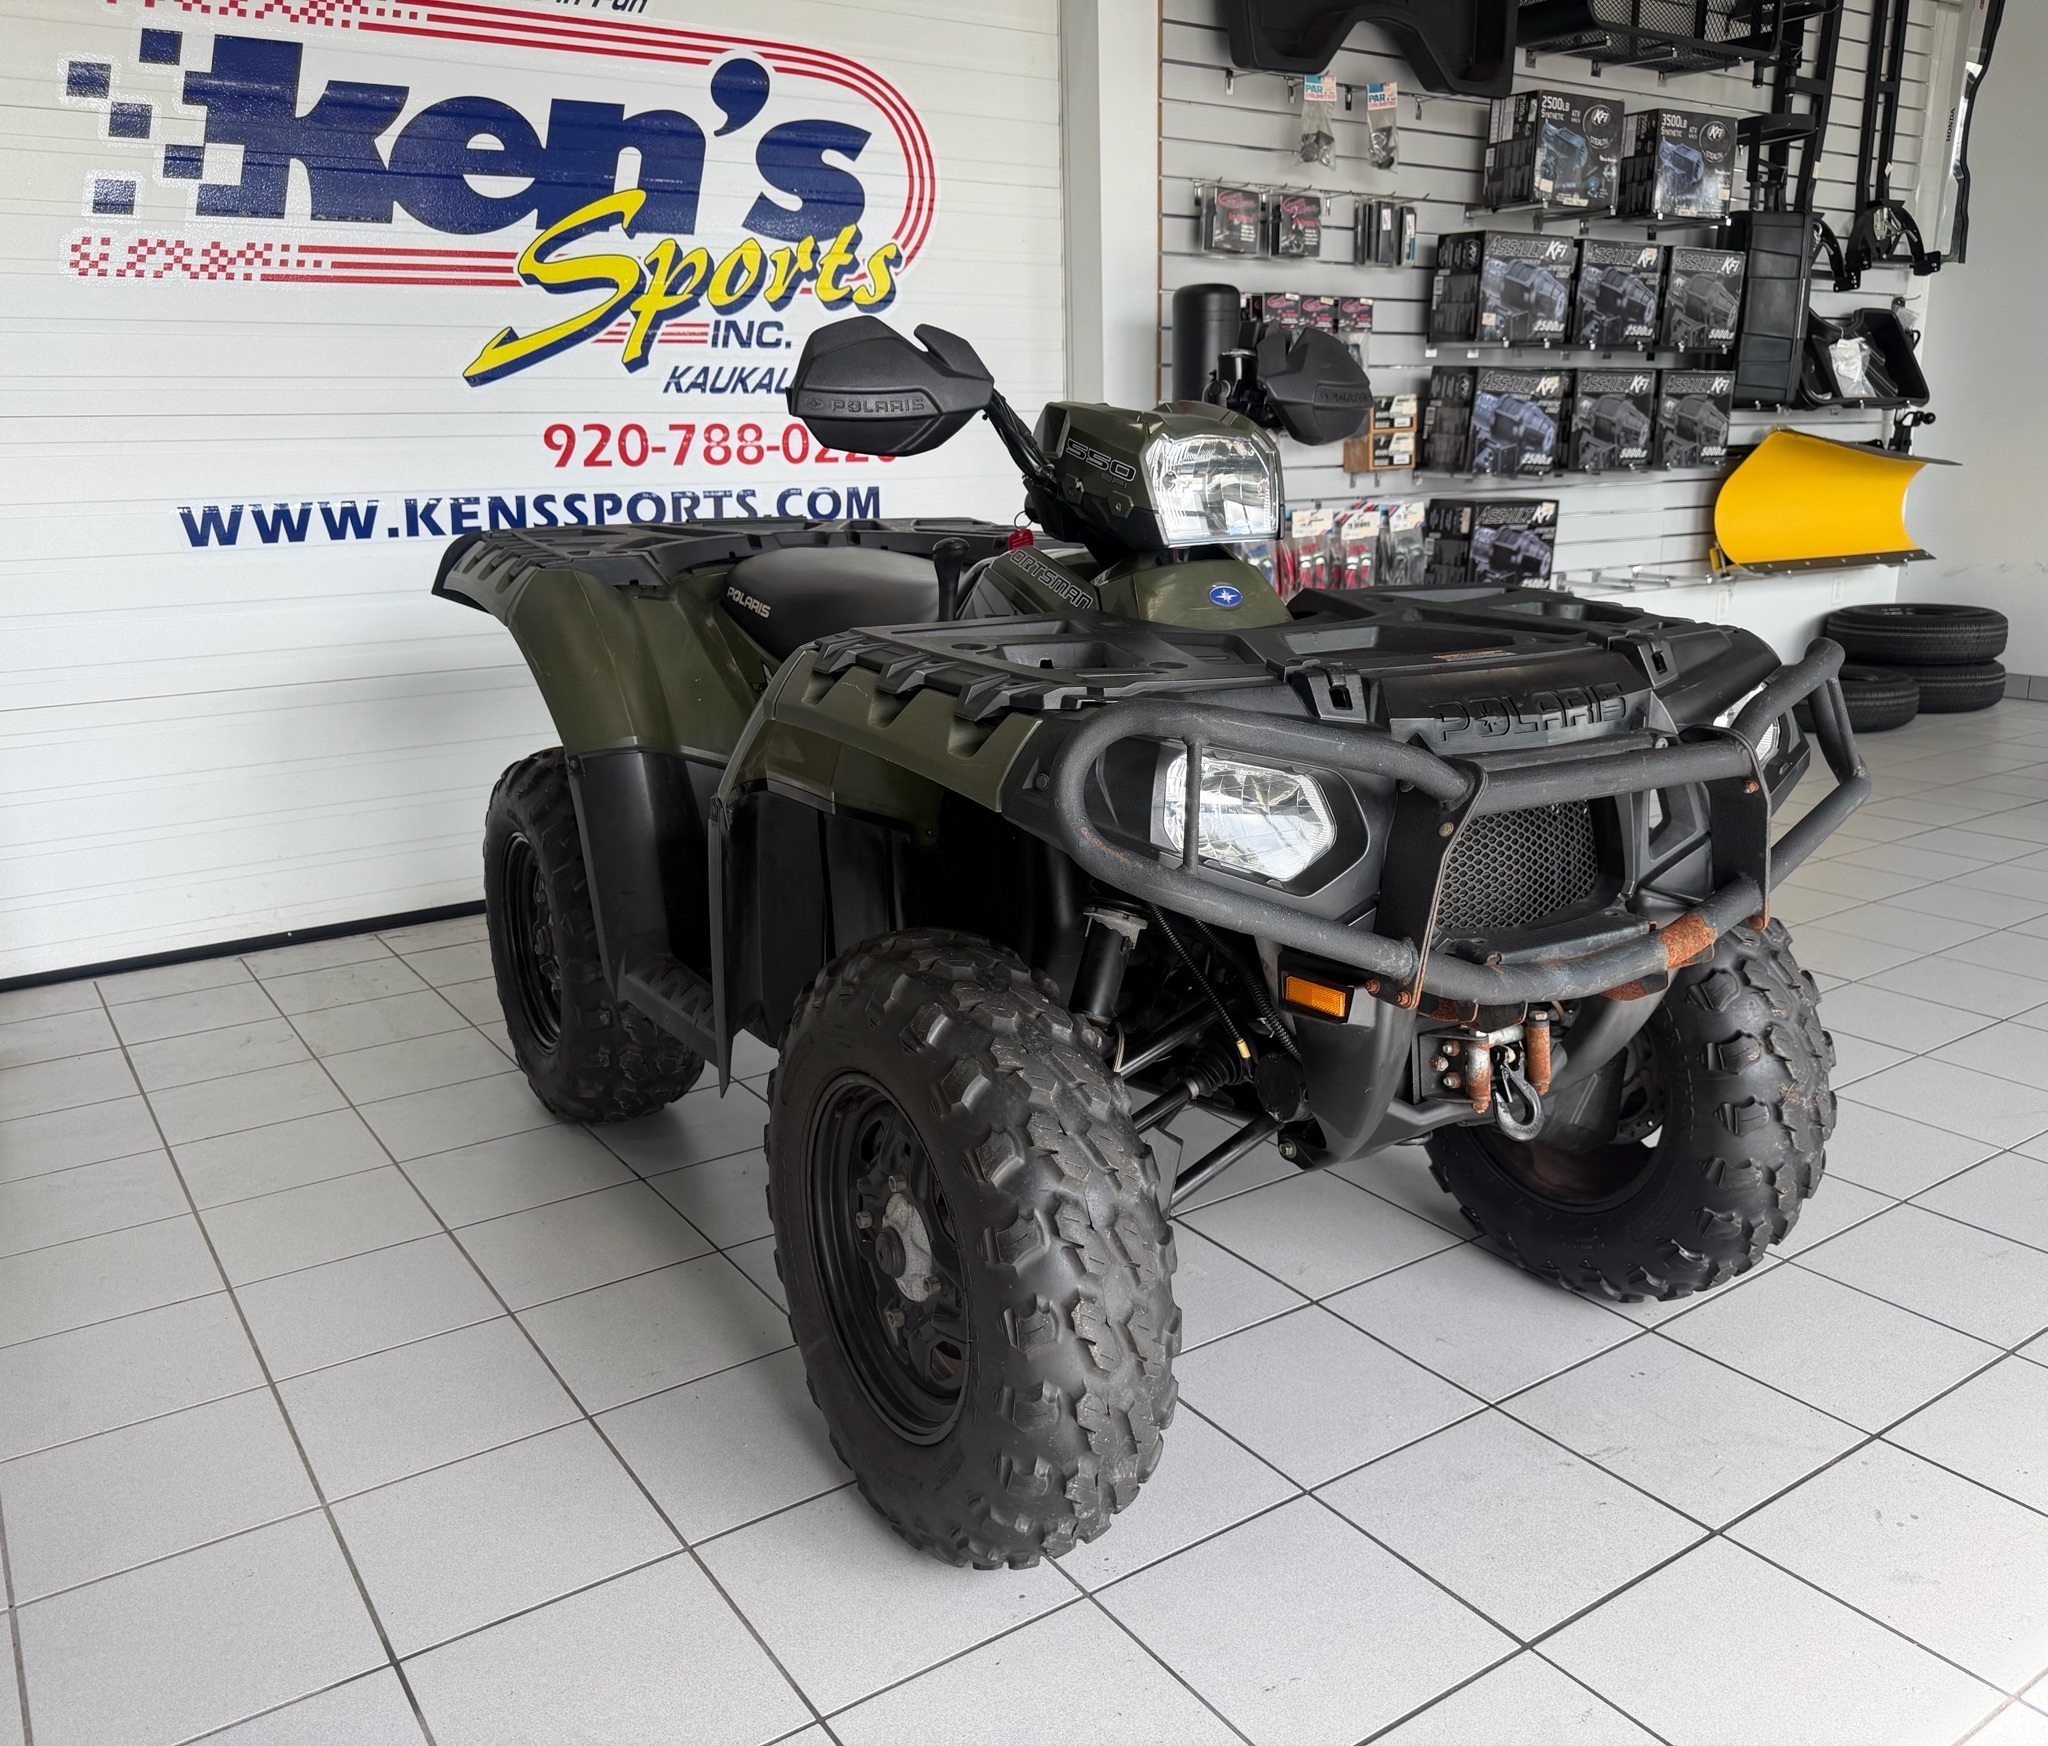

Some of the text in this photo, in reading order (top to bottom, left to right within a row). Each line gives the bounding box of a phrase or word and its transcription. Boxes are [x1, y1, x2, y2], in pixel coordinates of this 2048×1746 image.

[1305, 84, 1334, 95] PAR
[1368, 93, 1396, 103] PAR
[1945, 107, 1956, 142] HONDA
[1485, 235, 1548, 258] ASSAULT
[463, 189, 903, 387] Sports
[710, 320, 791, 349] INC.
[1477, 371, 1540, 393] ASSAULT
[831, 398, 925, 413] POLARIS
[543, 423, 898, 469] 920-788-0
[1065, 438, 1136, 481] 550
[177, 485, 881, 547] WWW.KENSSPORTSCOM
[727, 586, 771, 619] POLARIS
[1431, 682, 1627, 742] POLARIS
